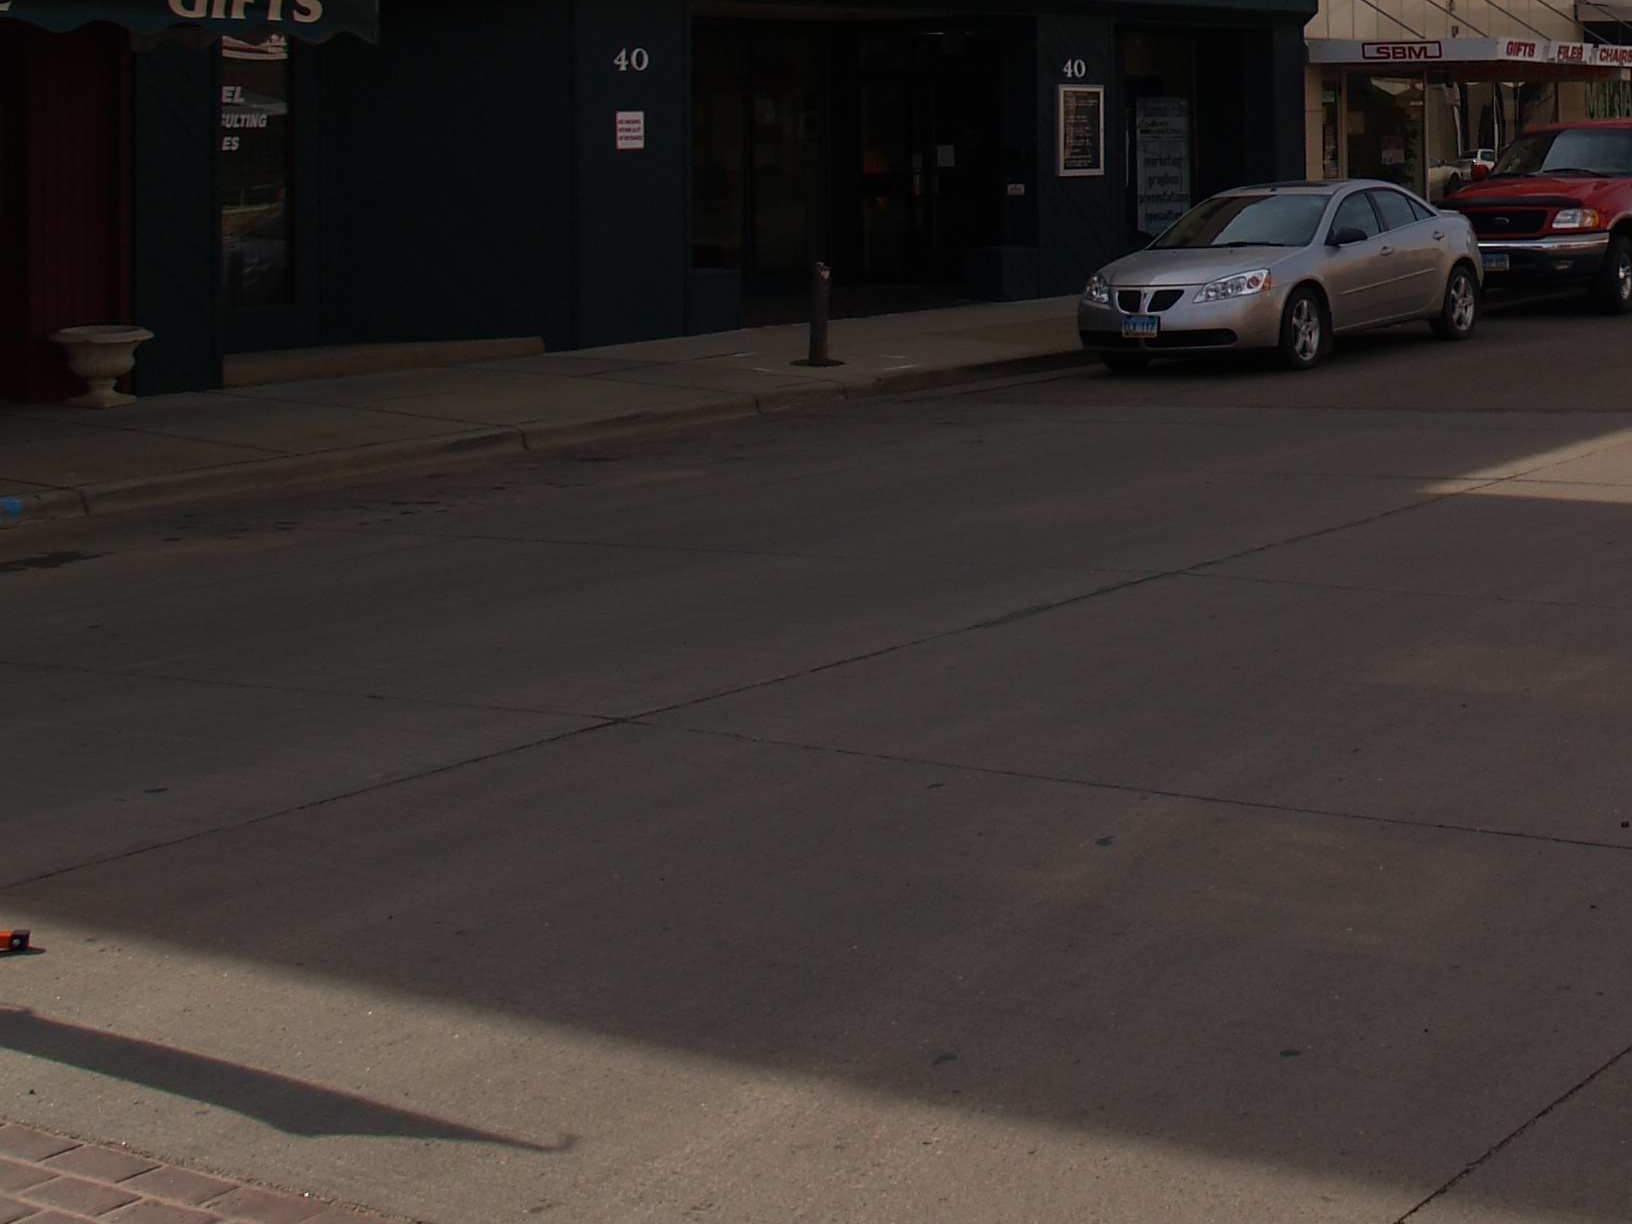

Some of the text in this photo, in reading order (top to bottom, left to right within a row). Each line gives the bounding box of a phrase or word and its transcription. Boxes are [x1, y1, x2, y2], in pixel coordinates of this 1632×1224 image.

[1376, 44, 1427, 60] SBM
[1505, 41, 1536, 58] GIFTS
[1556, 44, 1584, 62] FILES
[1597, 47, 1632, 65] CHAIRS
[612, 47, 650, 73] 40
[1061, 59, 1086, 79] 40
[221, 85, 244, 104] EL
[221, 136, 240, 152] ES
